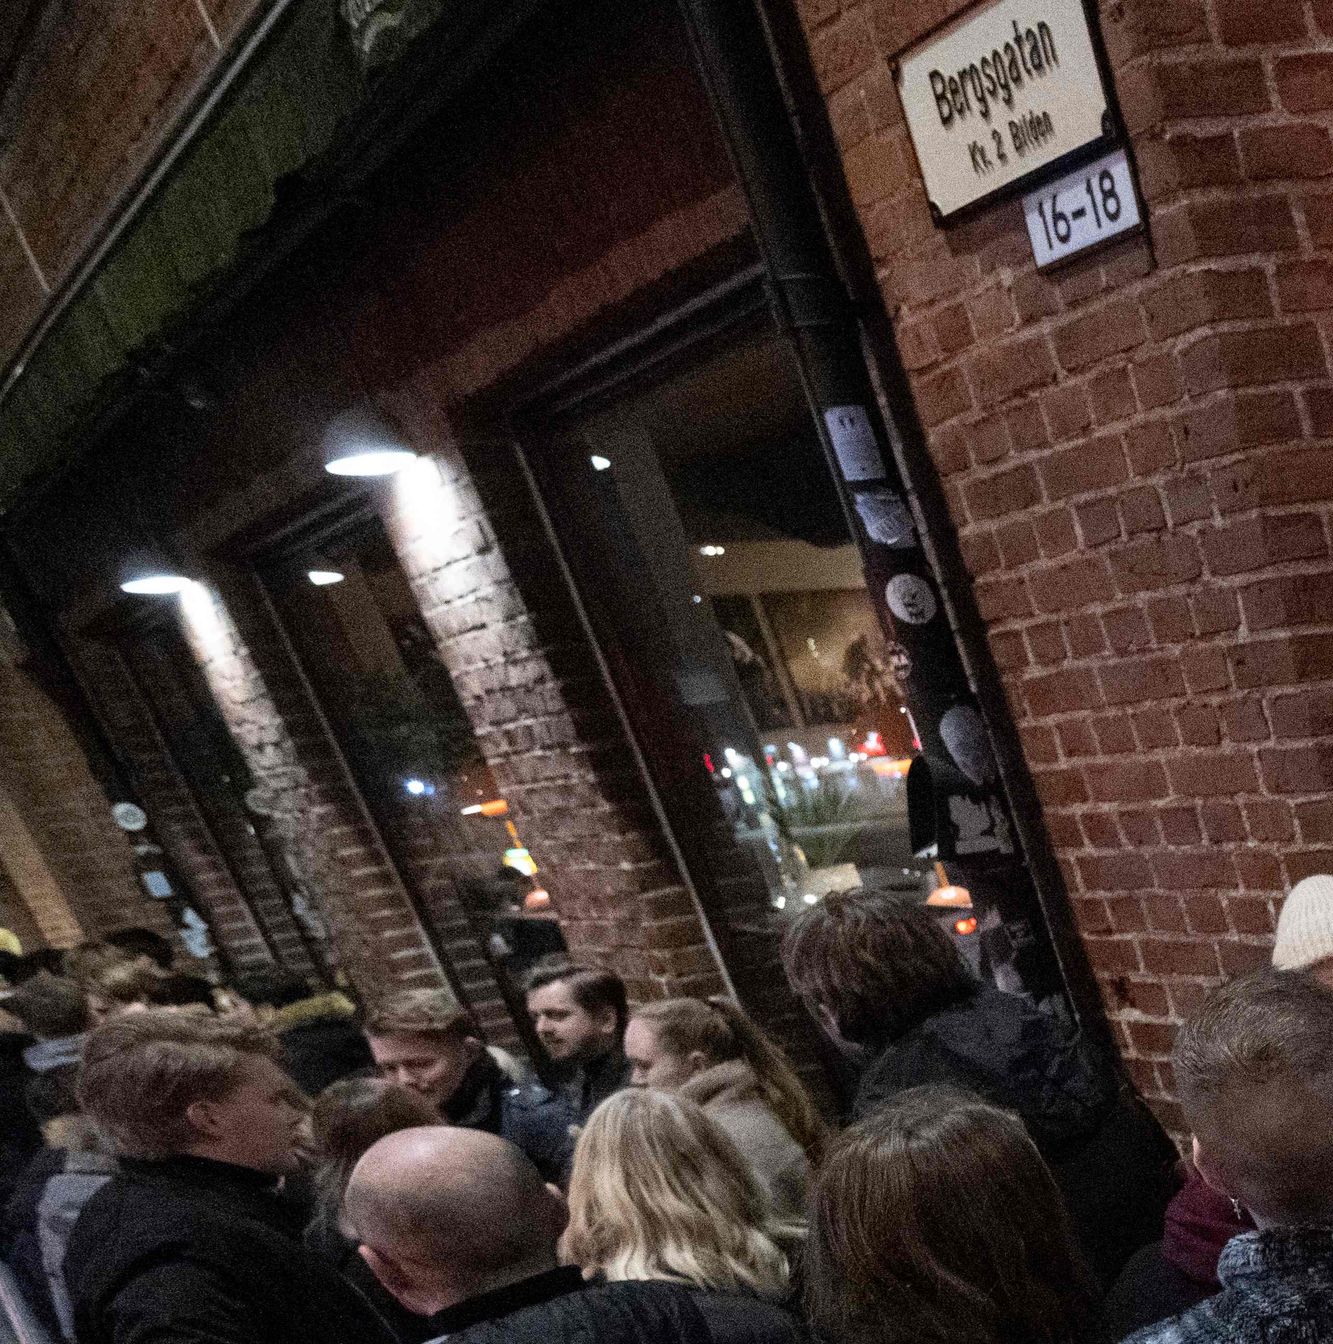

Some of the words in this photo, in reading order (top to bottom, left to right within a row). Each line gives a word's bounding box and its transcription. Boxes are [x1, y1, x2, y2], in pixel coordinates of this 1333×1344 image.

[928, 20, 1060, 127] Bergsgatan
[991, 128, 1008, 163] 2
[1038, 169, 1122, 250] 16-18
